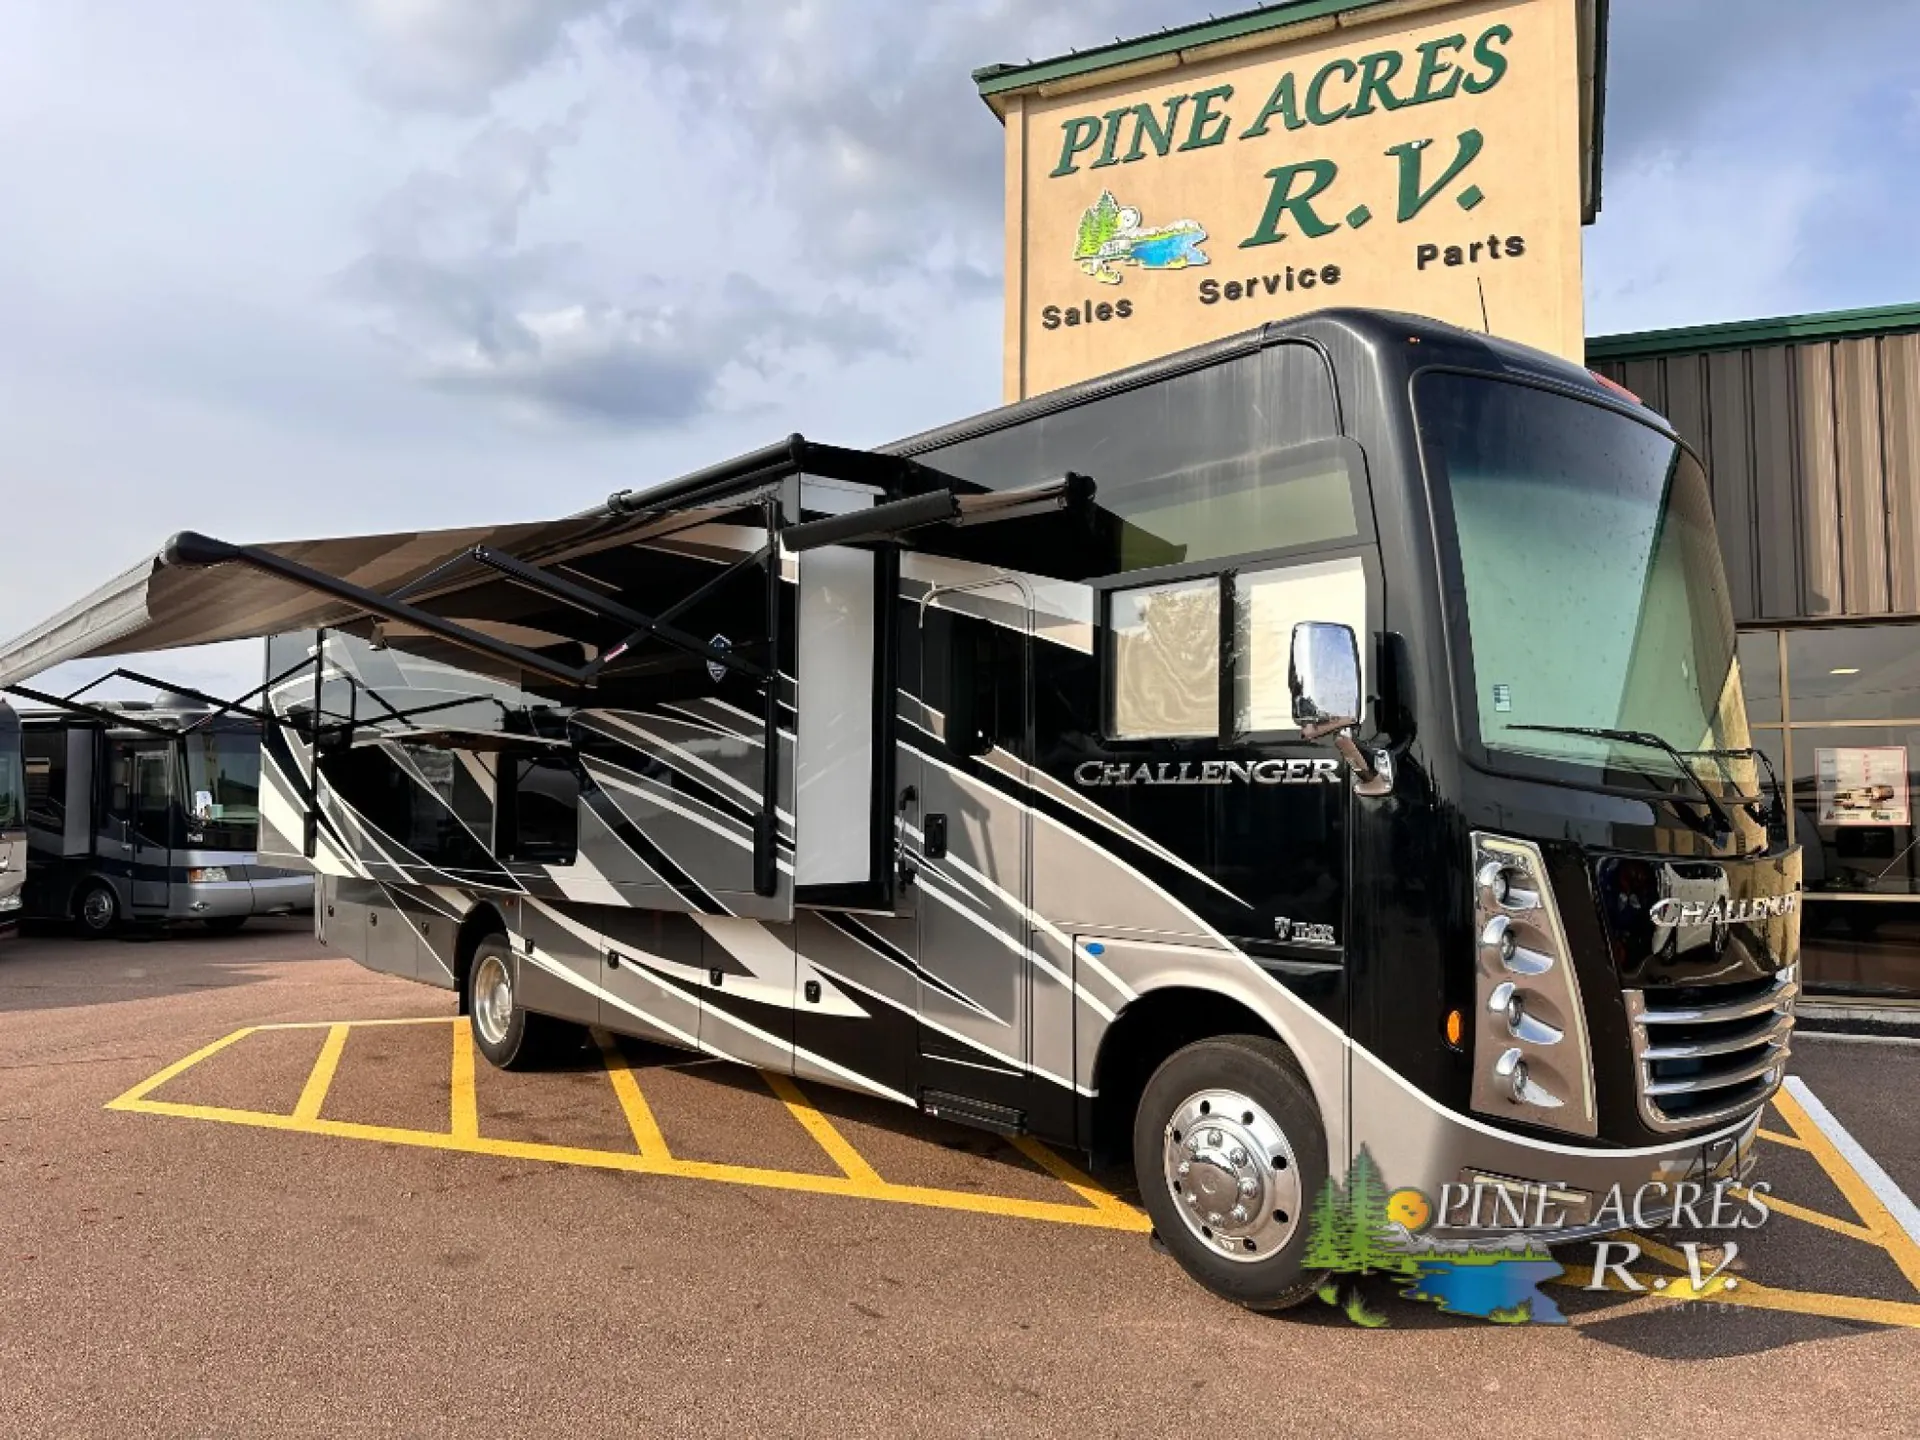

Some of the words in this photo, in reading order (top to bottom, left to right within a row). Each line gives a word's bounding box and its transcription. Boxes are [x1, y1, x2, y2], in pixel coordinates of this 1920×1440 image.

[1049, 84, 1234, 178] PINE
[1240, 23, 1512, 138] ACRES
[1239, 128, 1485, 249] R.V.
[1041, 296, 1133, 330] Sales
[1198, 260, 1341, 305] Service
[1416, 234, 1525, 271] Parts
[1074, 758, 1342, 786] CHALLENGER
